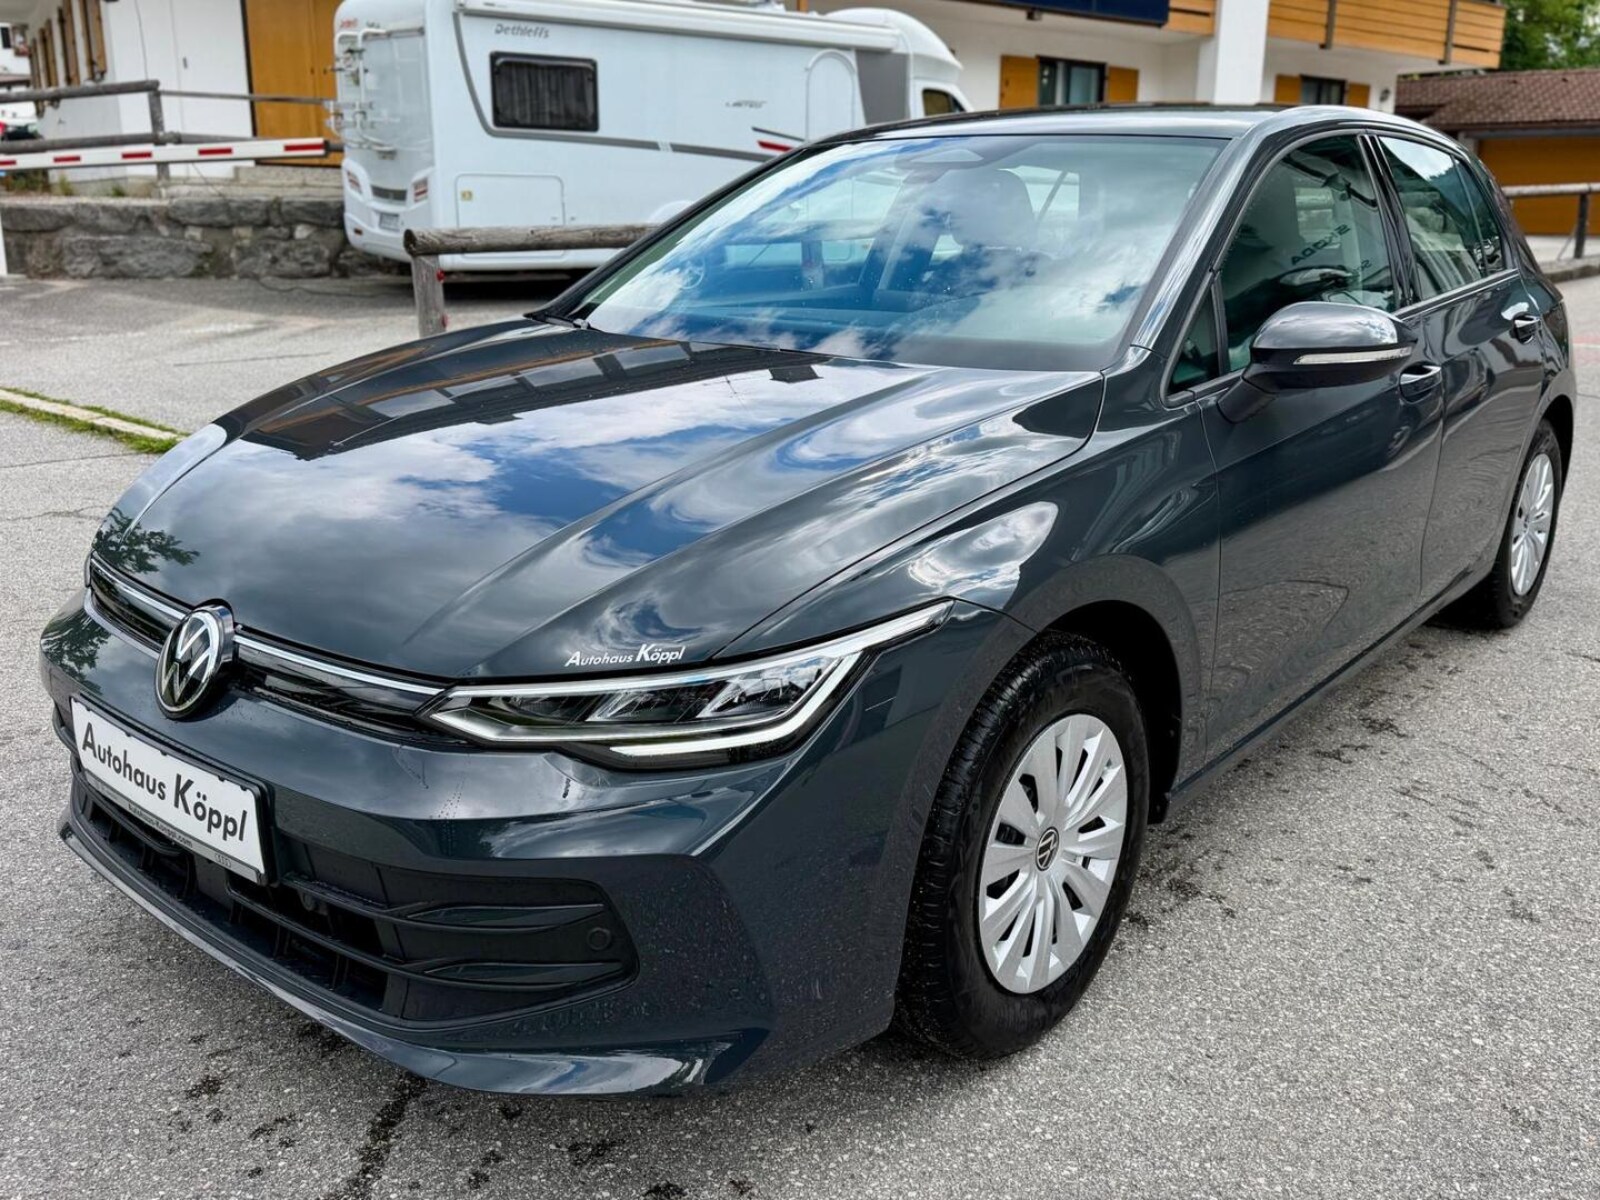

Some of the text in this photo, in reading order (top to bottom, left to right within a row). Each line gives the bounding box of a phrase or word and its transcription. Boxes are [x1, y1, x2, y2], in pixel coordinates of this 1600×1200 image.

[494, 23, 550, 39] Dethleffs
[564, 643, 686, 667] Autohaus Köppl
[82, 722, 247, 842] Autohaus Köppl
